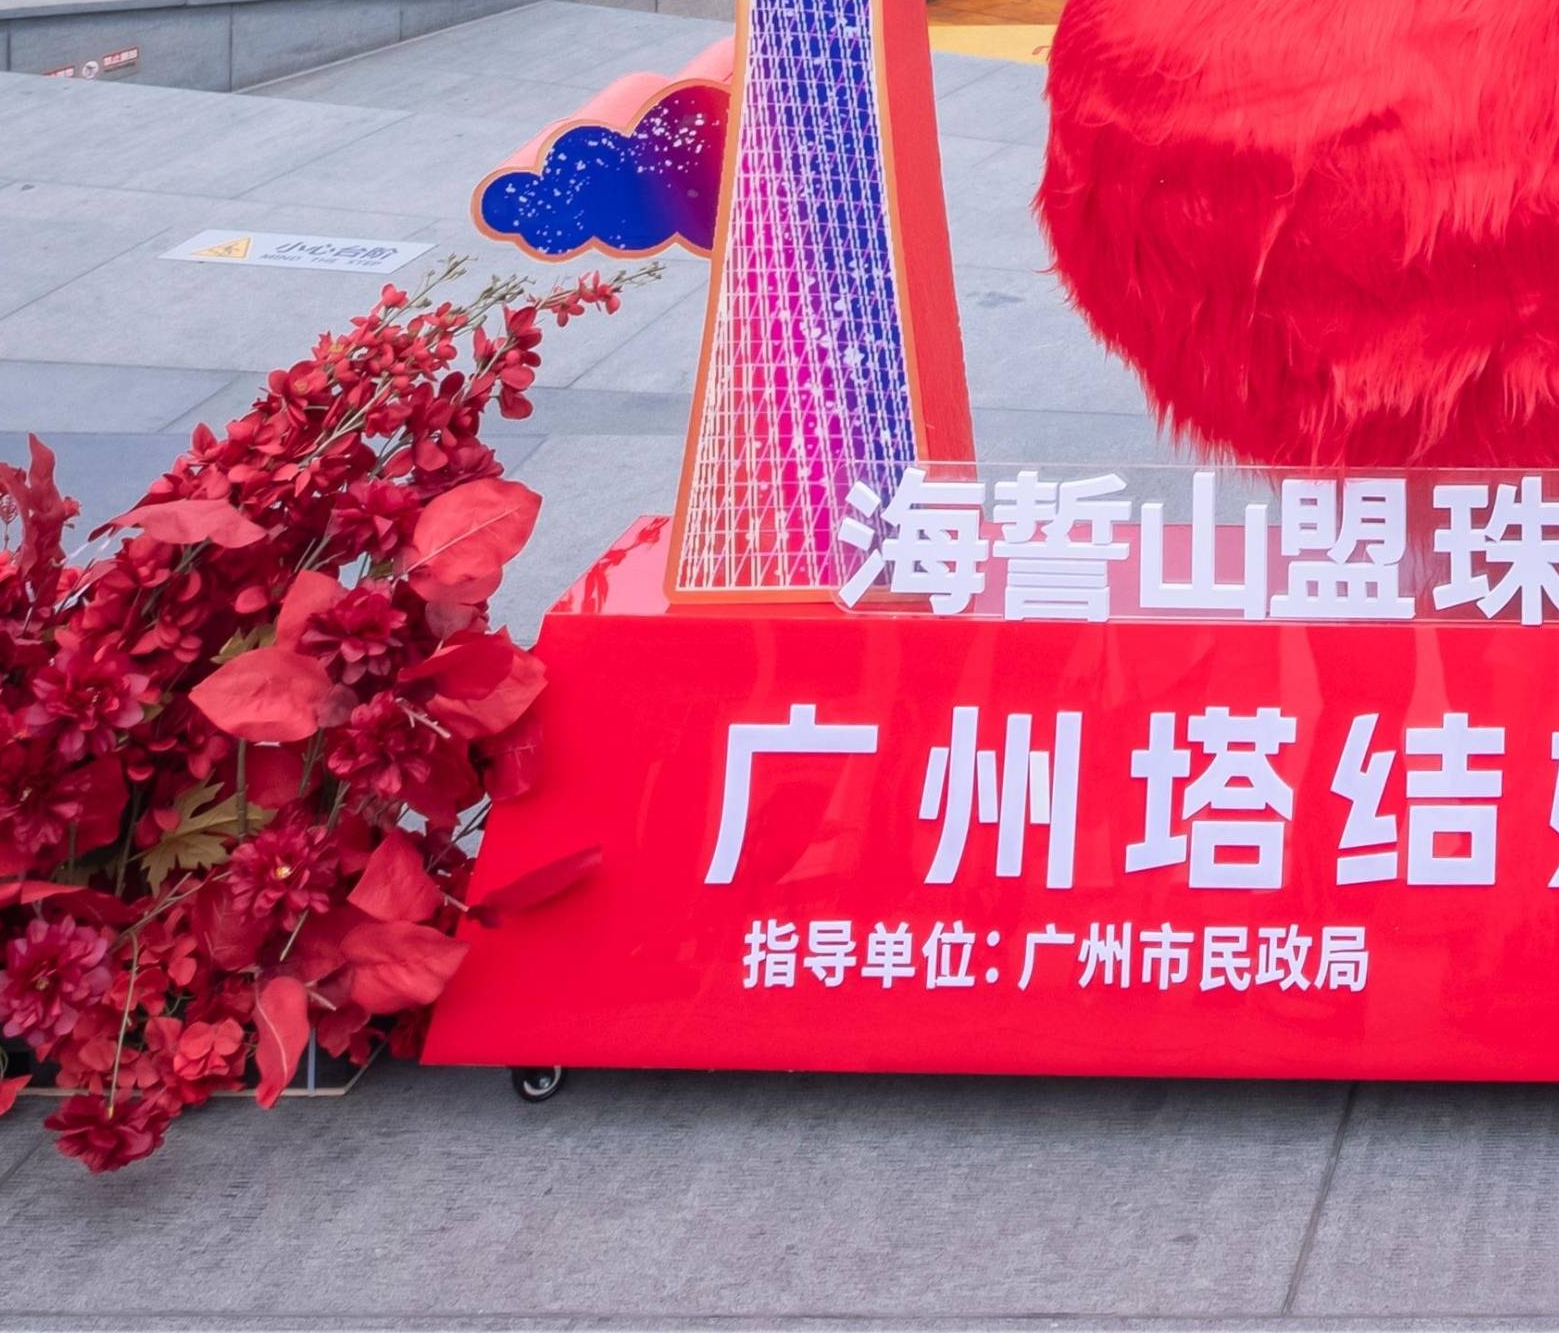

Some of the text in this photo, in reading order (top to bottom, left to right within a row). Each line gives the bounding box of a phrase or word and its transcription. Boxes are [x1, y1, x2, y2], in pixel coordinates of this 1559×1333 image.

[275, 241, 398, 261] 小心台阶
[259, 253, 382, 267] MIND THE STEP
